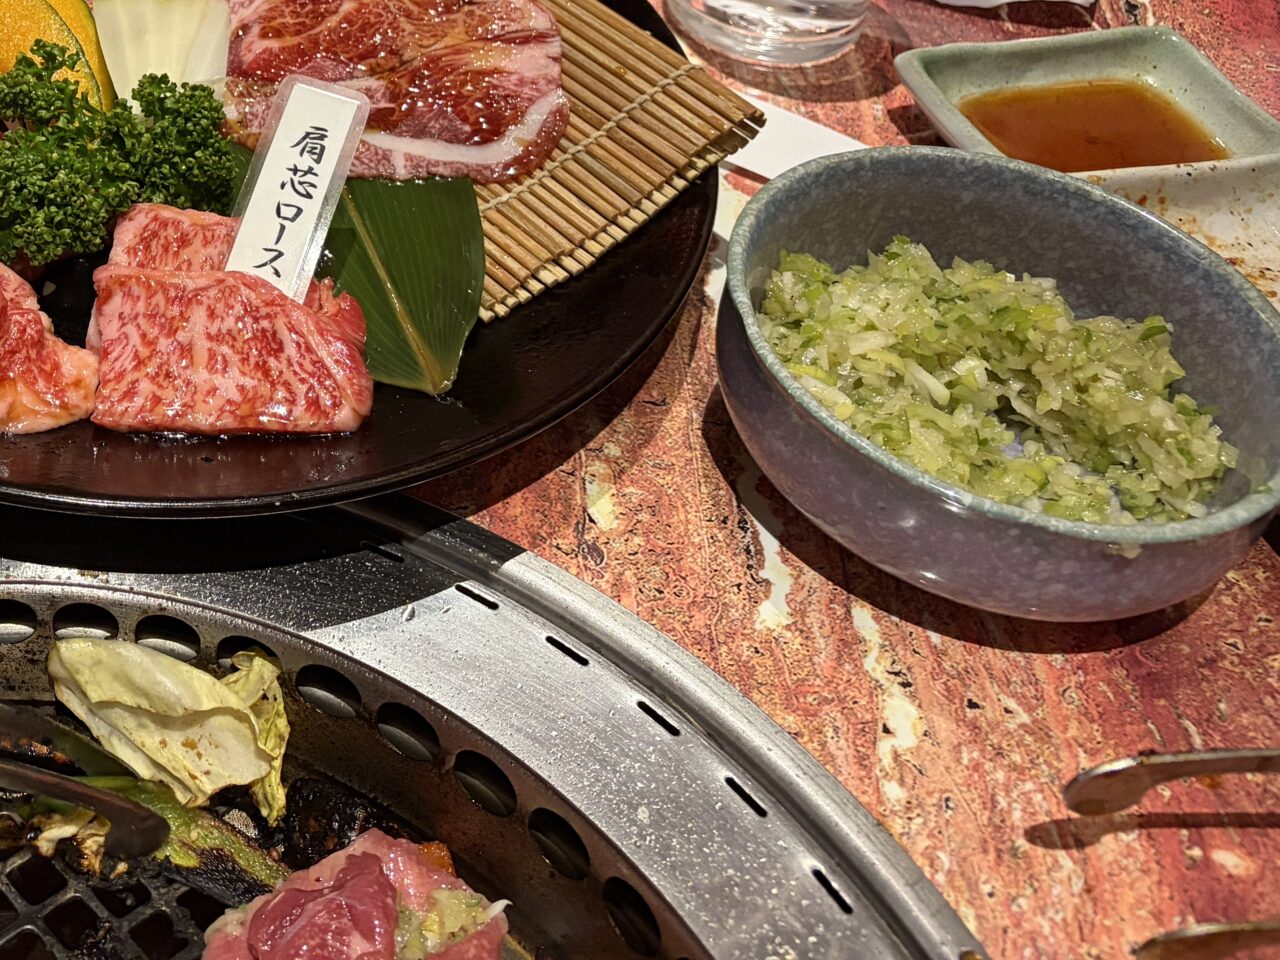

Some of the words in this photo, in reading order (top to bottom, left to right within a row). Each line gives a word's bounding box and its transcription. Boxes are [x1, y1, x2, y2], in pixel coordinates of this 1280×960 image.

[253, 126, 329, 278] 肩芯ロース
